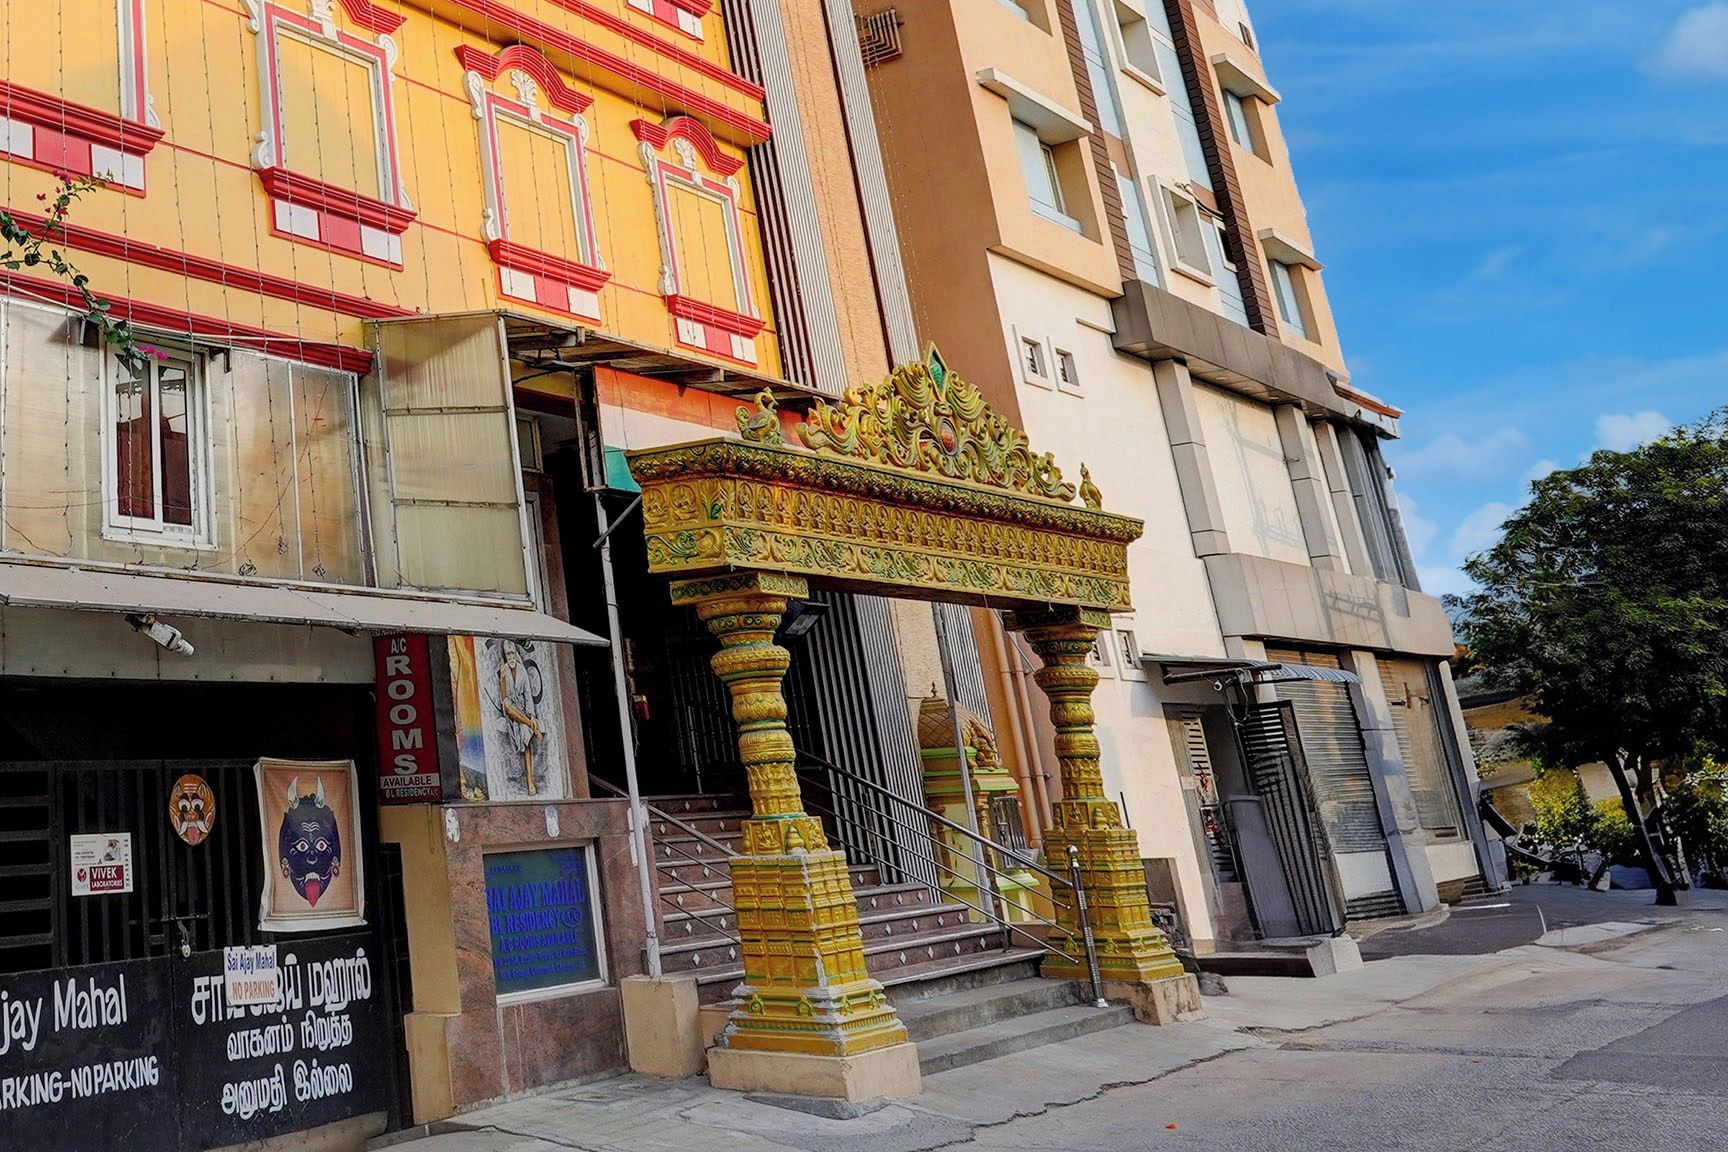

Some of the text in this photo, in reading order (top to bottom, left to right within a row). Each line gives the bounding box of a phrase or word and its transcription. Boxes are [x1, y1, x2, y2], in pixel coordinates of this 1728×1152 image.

[390, 638, 407, 654] A/C
[385, 655, 423, 775] ROOMS
[383, 775, 432, 787] AVAILABLE
[92, 867, 118, 879] VIVEK
[510, 882, 539, 910] AJAY
[541, 879, 585, 906] MAHAL
[507, 909, 561, 933] RESIDENCY
[227, 951, 275, 975] Sai Ajay Mahal
[232, 980, 275, 1000] NO PARKING
[54, 973, 127, 1032] Mahal
[227, 1010, 353, 1061] வாகனம் நிறுத்த
[221, 1058, 353, 1120] அனுமதி இல்லை
